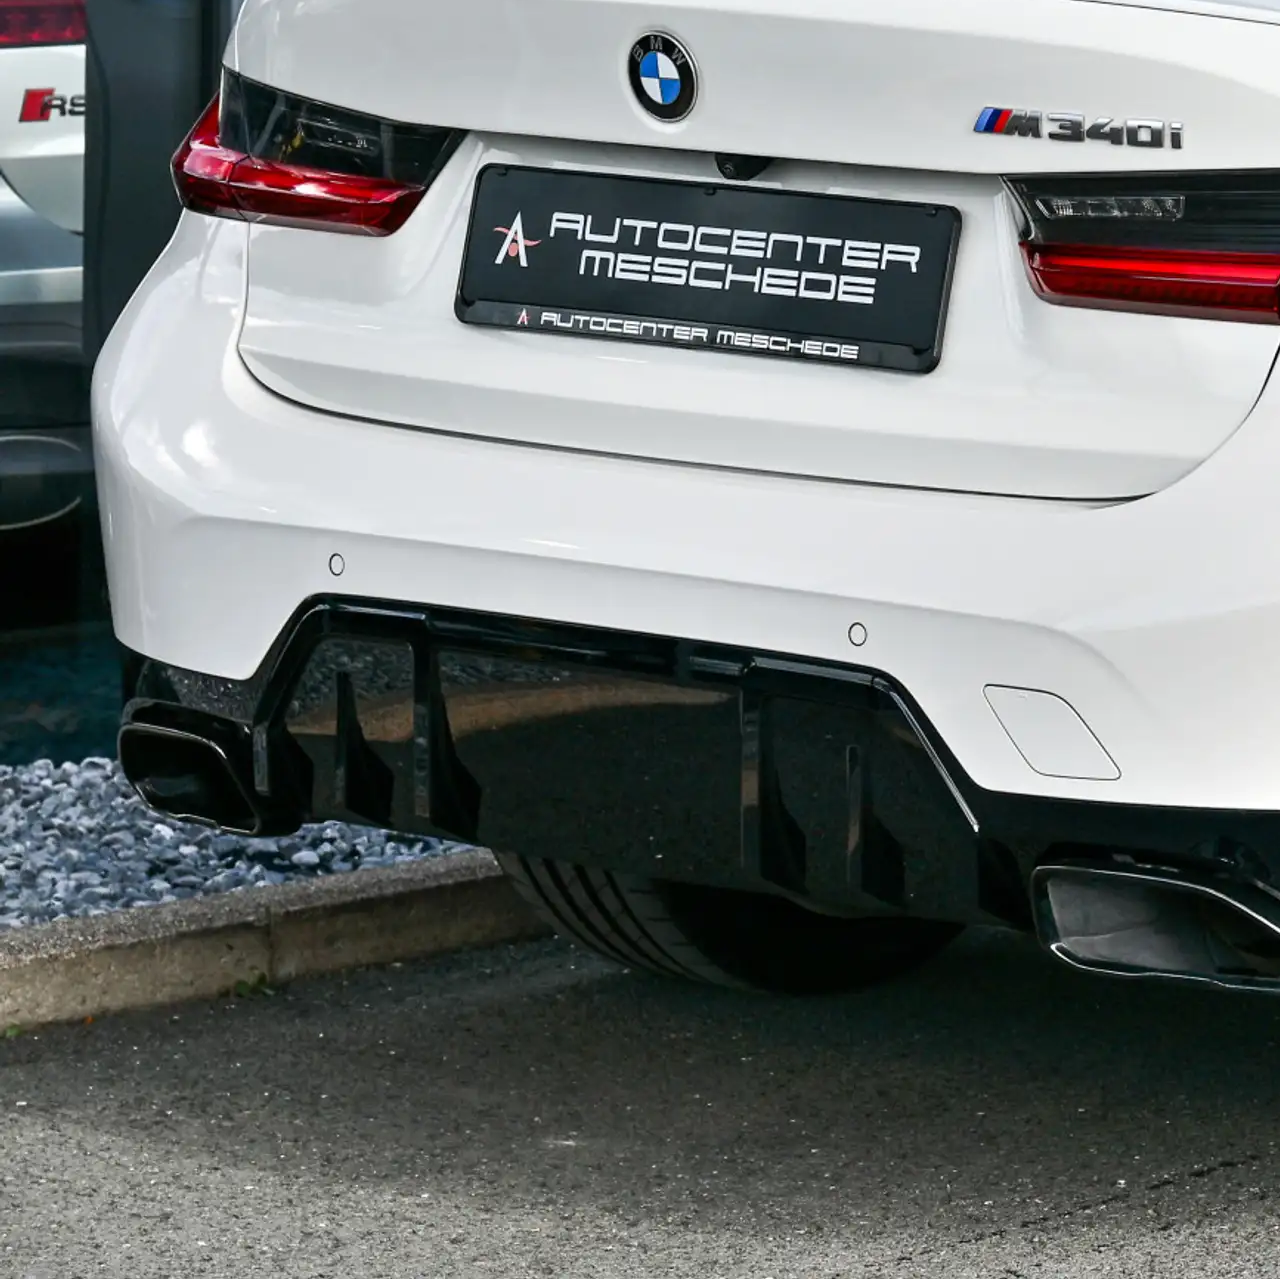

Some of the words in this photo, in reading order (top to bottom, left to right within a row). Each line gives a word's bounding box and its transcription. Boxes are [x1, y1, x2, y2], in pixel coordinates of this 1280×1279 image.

[631, 35, 687, 66] BMW
[1000, 107, 1184, 150] M340i
[549, 211, 922, 274] AUTOCENTER
[578, 249, 877, 305] MESCHEDE
[540, 311, 708, 343] AUTOCENTER
[716, 330, 860, 360] MESCHEDE
